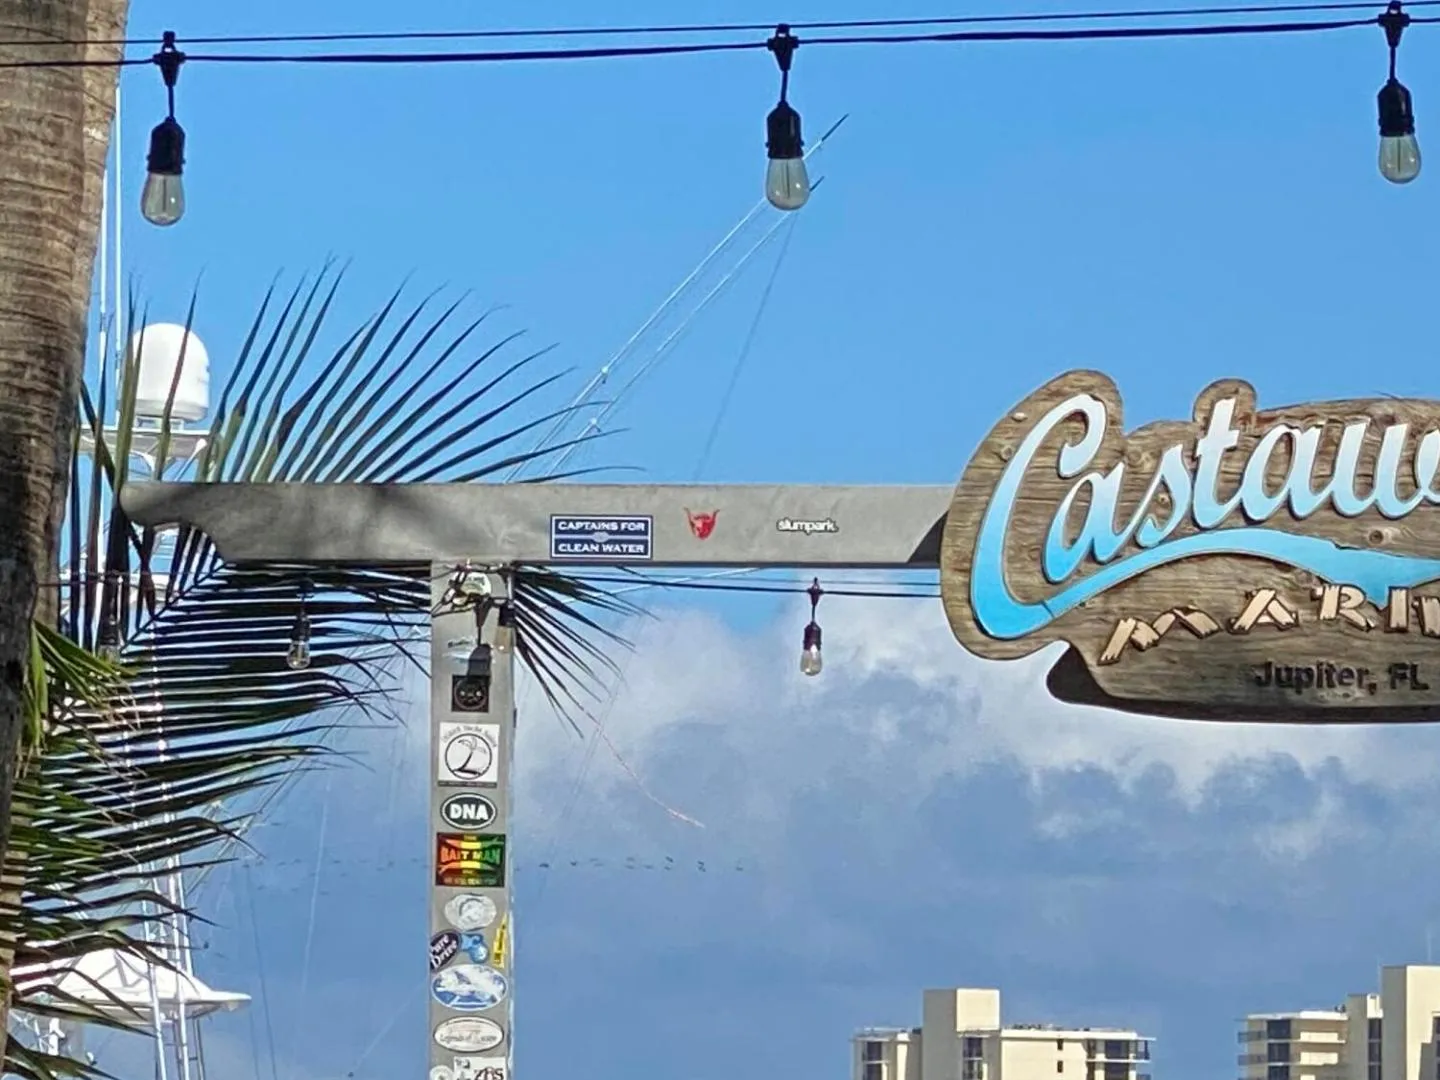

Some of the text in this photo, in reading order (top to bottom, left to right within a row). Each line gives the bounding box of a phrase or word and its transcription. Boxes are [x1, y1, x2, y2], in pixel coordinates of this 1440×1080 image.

[558, 521, 645, 532] CAPTAINS FOR
[558, 543, 645, 554] CLEAN WATER
[1253, 660, 1430, 694] Jupiter, FL
[450, 803, 488, 820] DNA
